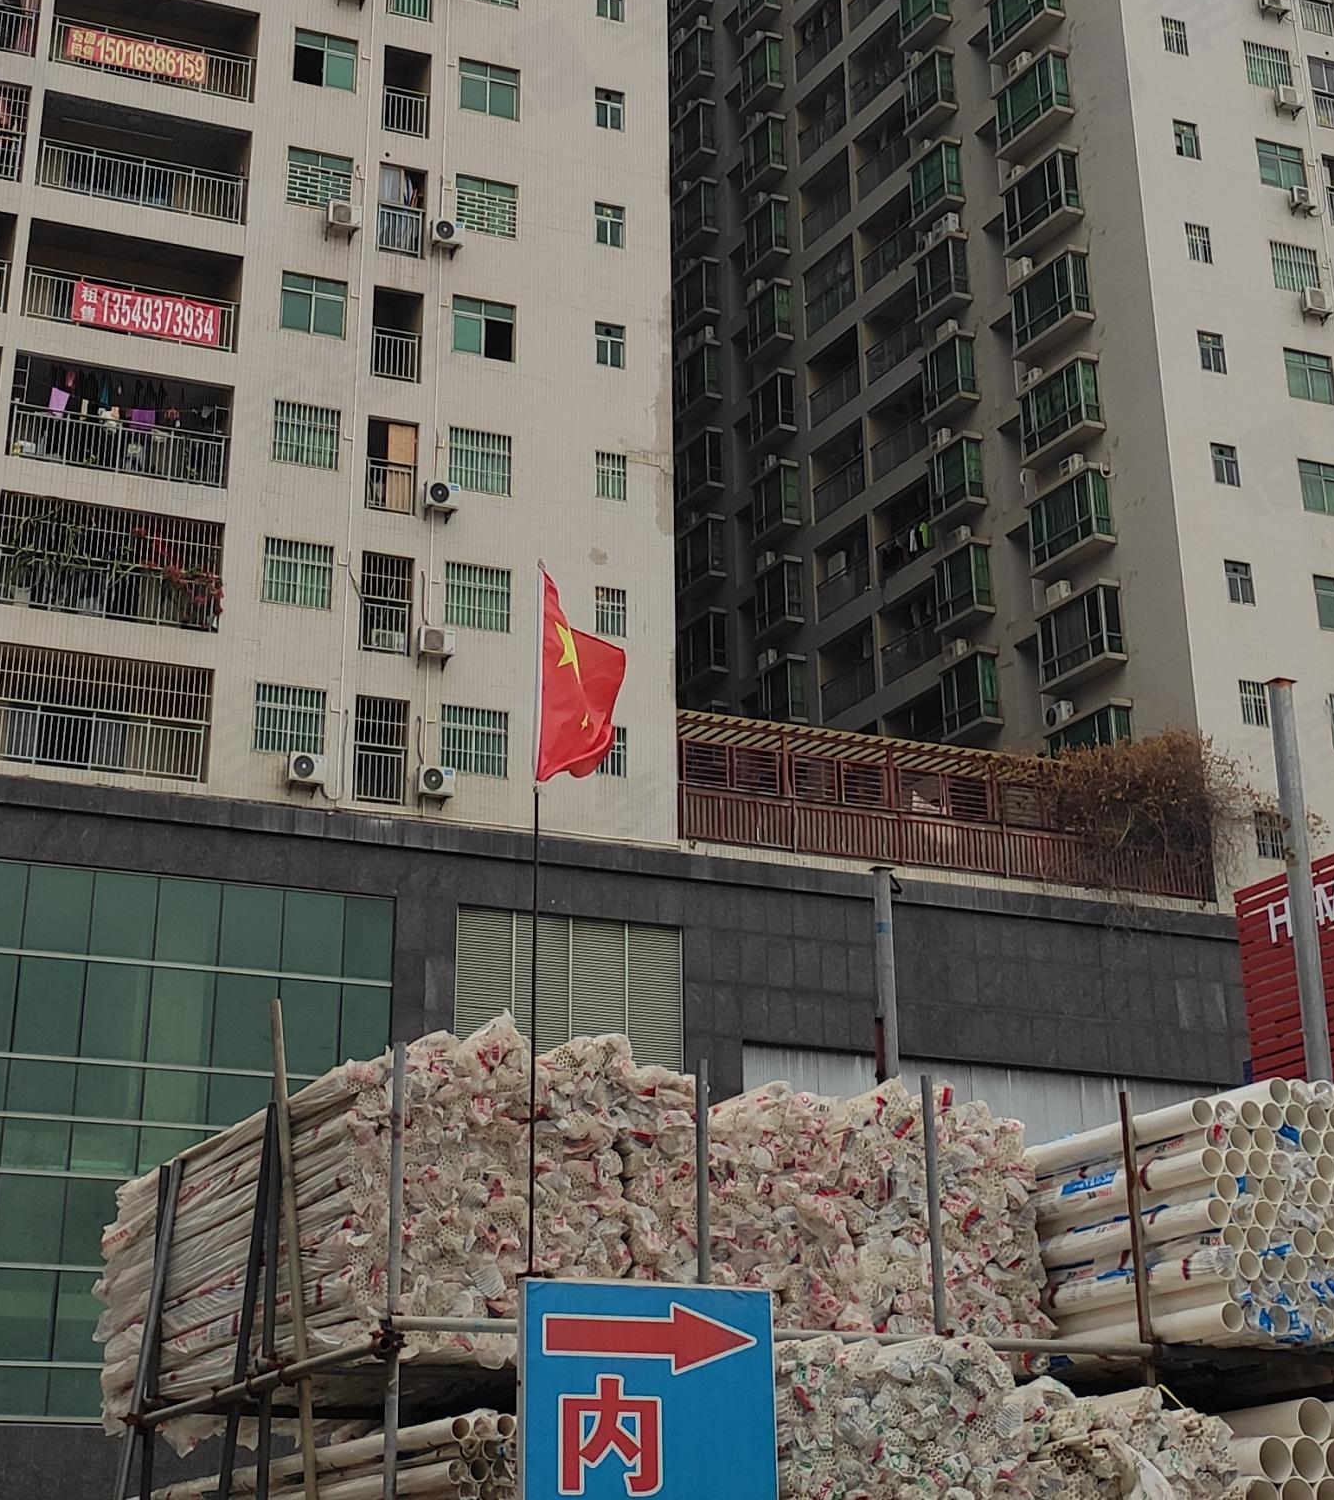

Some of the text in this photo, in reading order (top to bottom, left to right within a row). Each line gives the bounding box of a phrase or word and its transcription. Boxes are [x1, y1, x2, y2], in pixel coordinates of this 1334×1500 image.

[97, 35, 206, 83] 15016986159
[80, 286, 99, 323] 租售
[102, 290, 215, 343] 13549373934
[557, 1372, 664, 1497] 内
